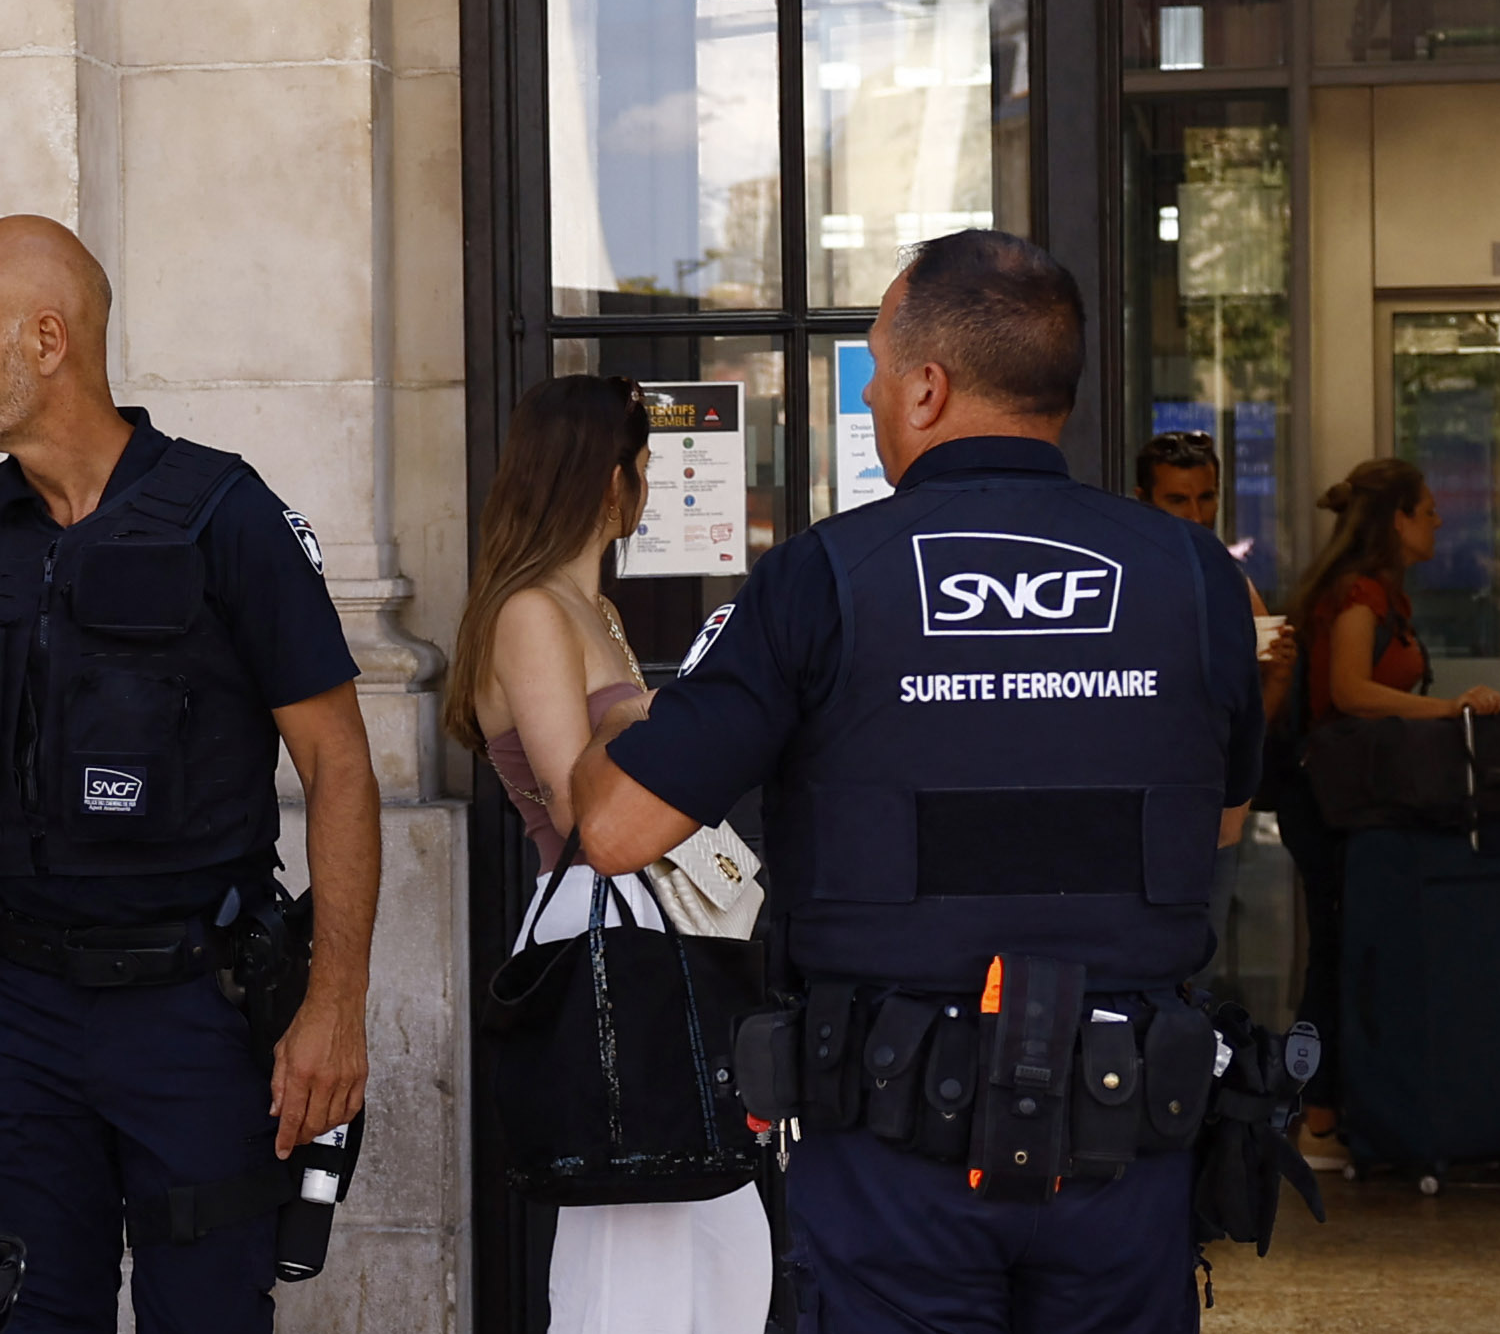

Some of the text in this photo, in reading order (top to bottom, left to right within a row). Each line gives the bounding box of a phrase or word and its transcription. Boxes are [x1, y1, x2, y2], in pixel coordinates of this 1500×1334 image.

[650, 416, 696, 428] SEMBLE
[934, 569, 1108, 621] SNCF
[900, 670, 1158, 702] SURETE FERROVIAIRE
[89, 780, 138, 796] SNCF
